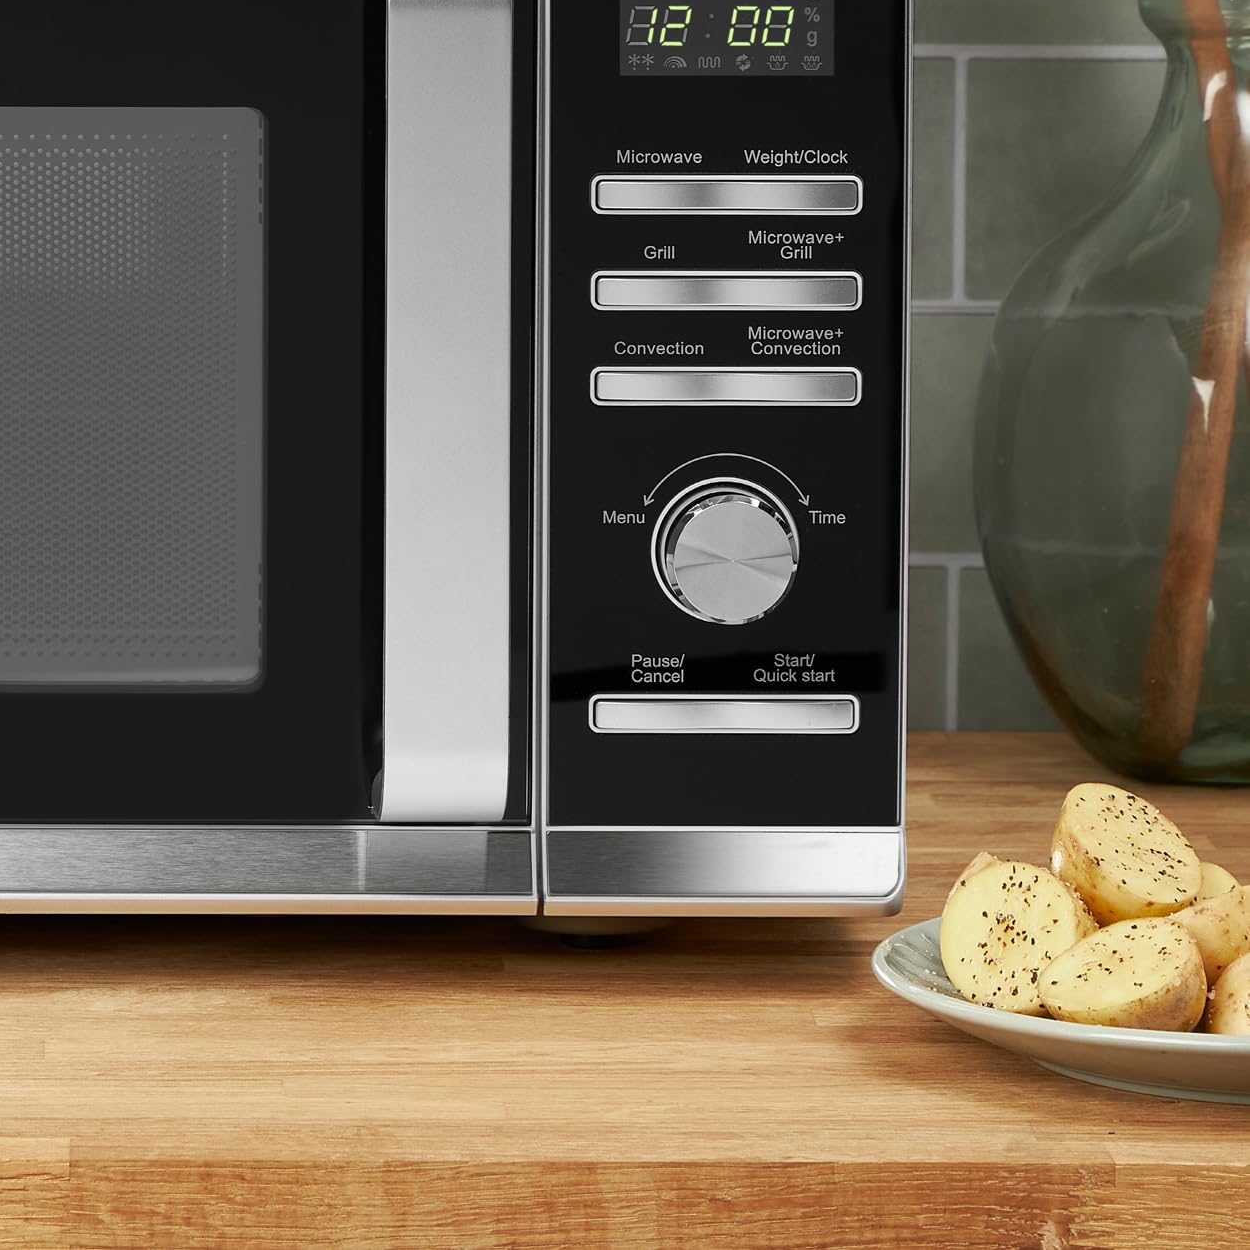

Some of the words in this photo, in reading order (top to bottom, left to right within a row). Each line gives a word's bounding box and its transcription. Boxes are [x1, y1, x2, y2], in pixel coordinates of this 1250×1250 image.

[804, 7, 820, 22] %
[806, 31, 818, 47] g
[616, 150, 703, 164] Microwave
[744, 150, 849, 167] Weight/Clock
[748, 230, 845, 245] Microwave+
[643, 245, 675, 260] Grill
[780, 245, 813, 260] Grill
[748, 326, 845, 340] Microwave+
[614, 341, 704, 355] Convection
[750, 341, 841, 355] Convection
[602, 510, 646, 524] Menu
[808, 510, 846, 524] Time
[631, 653, 685, 668] Pause/
[773, 653, 815, 668] Start/
[631, 669, 685, 683] Cancel
[753, 668, 797, 683] Quick
[802, 668, 836, 682] start
